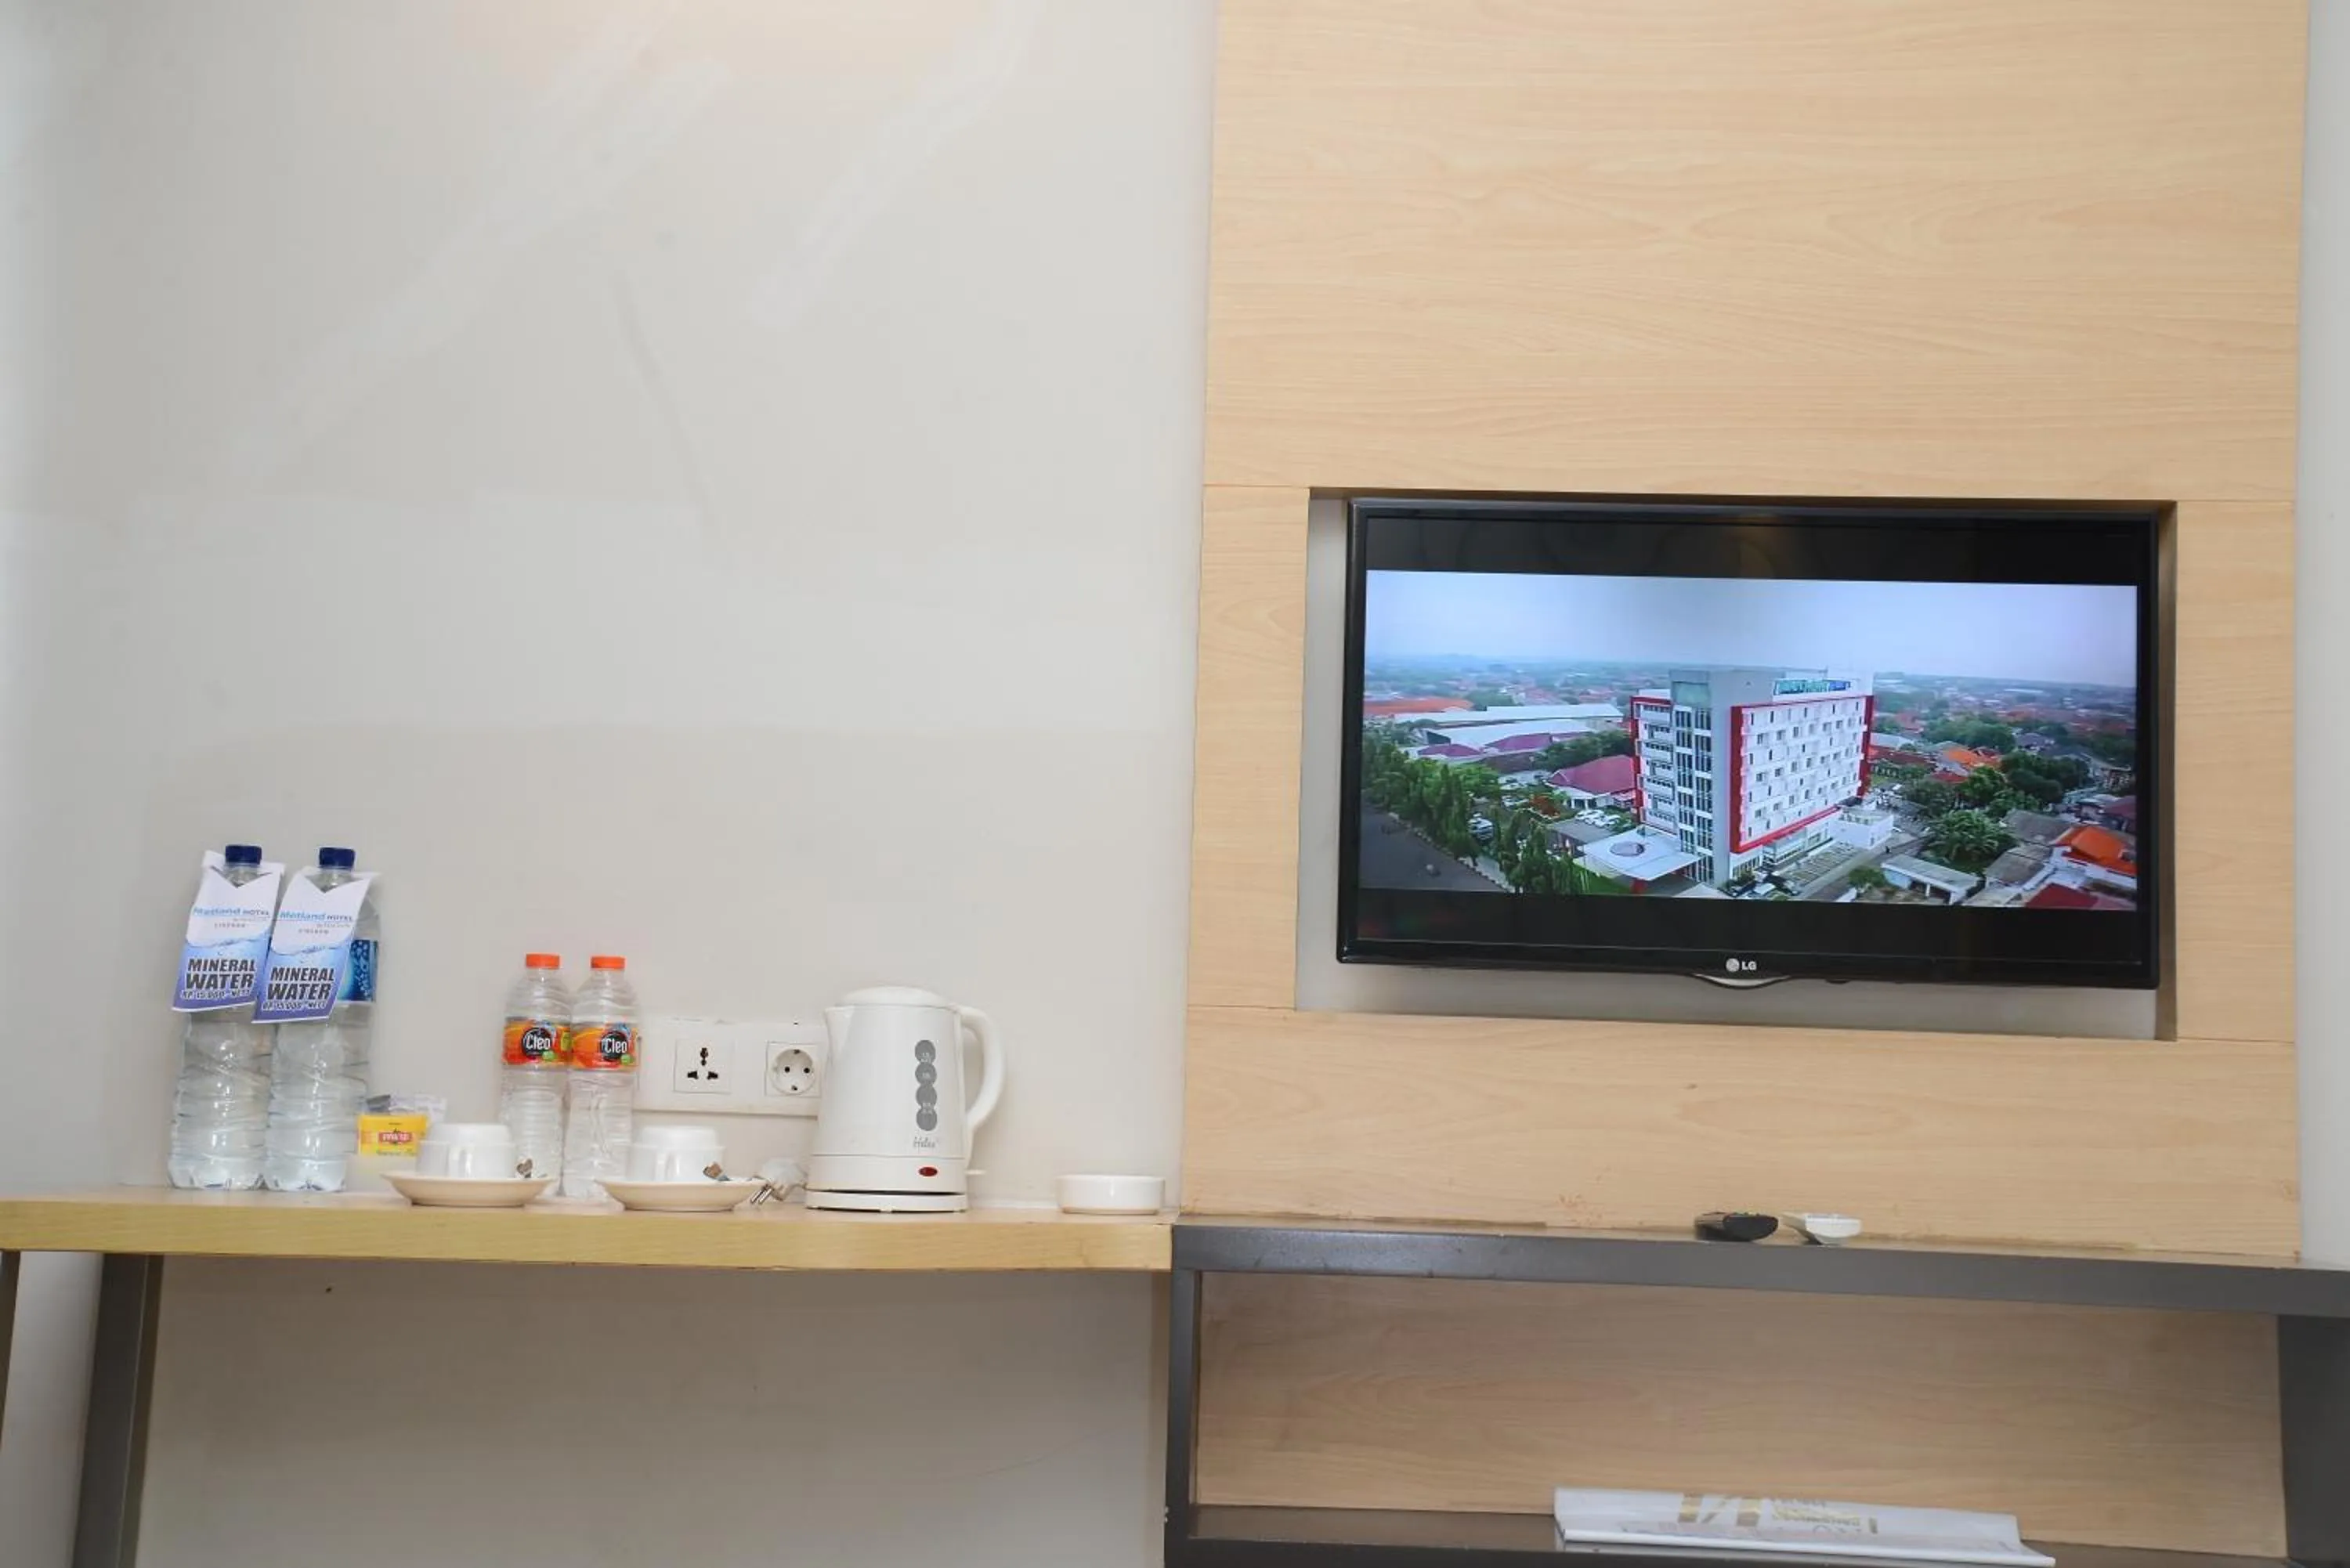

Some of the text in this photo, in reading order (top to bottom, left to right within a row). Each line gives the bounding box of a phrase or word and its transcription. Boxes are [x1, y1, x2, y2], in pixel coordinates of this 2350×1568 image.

[187, 958, 256, 972] MINERAL
[1741, 961, 1757, 970] LG
[186, 973, 255, 989] WATER
[270, 966, 335, 981] MINERAL
[267, 983, 332, 1000] WATER
[525, 1033, 551, 1050] Cleo
[604, 1037, 627, 1053] Cleo
